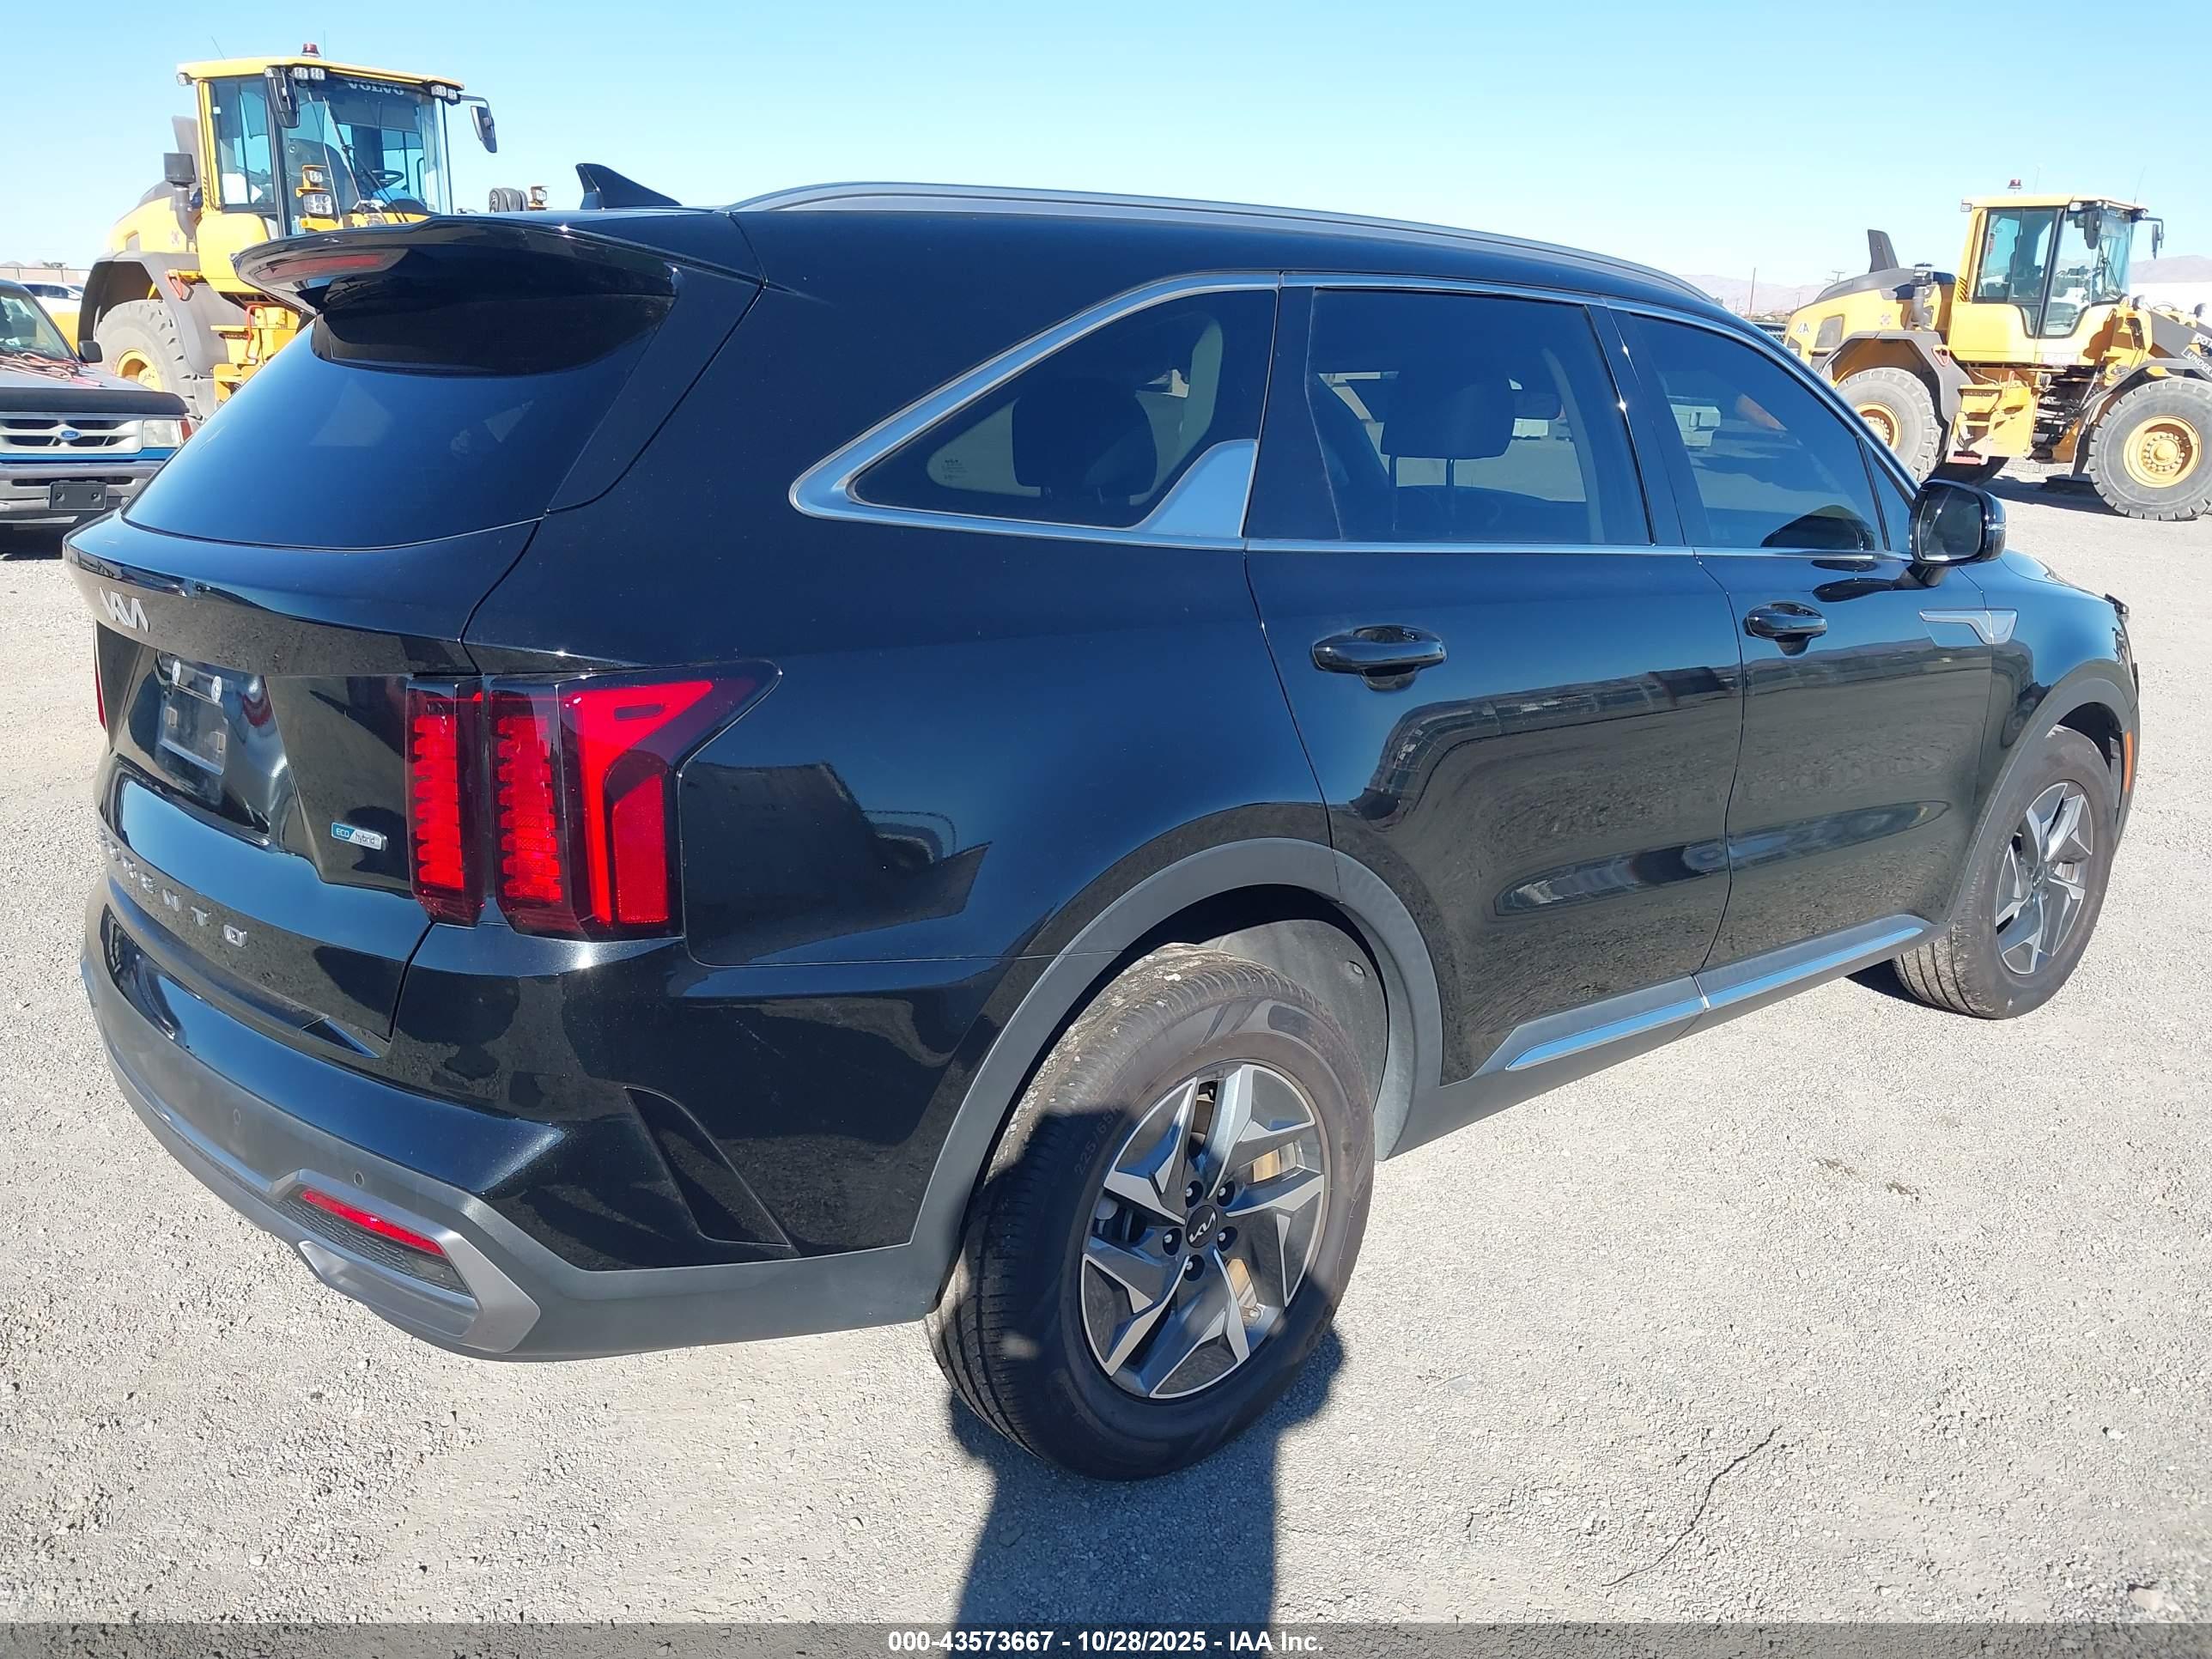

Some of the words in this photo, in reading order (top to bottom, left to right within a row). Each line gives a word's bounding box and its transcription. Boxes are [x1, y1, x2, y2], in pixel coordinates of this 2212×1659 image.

[348, 82, 404, 95] VOLVO
[99, 586, 150, 633] KIA
[336, 828, 350, 838] ECO
[1188, 1211, 1216, 1243] KIA
